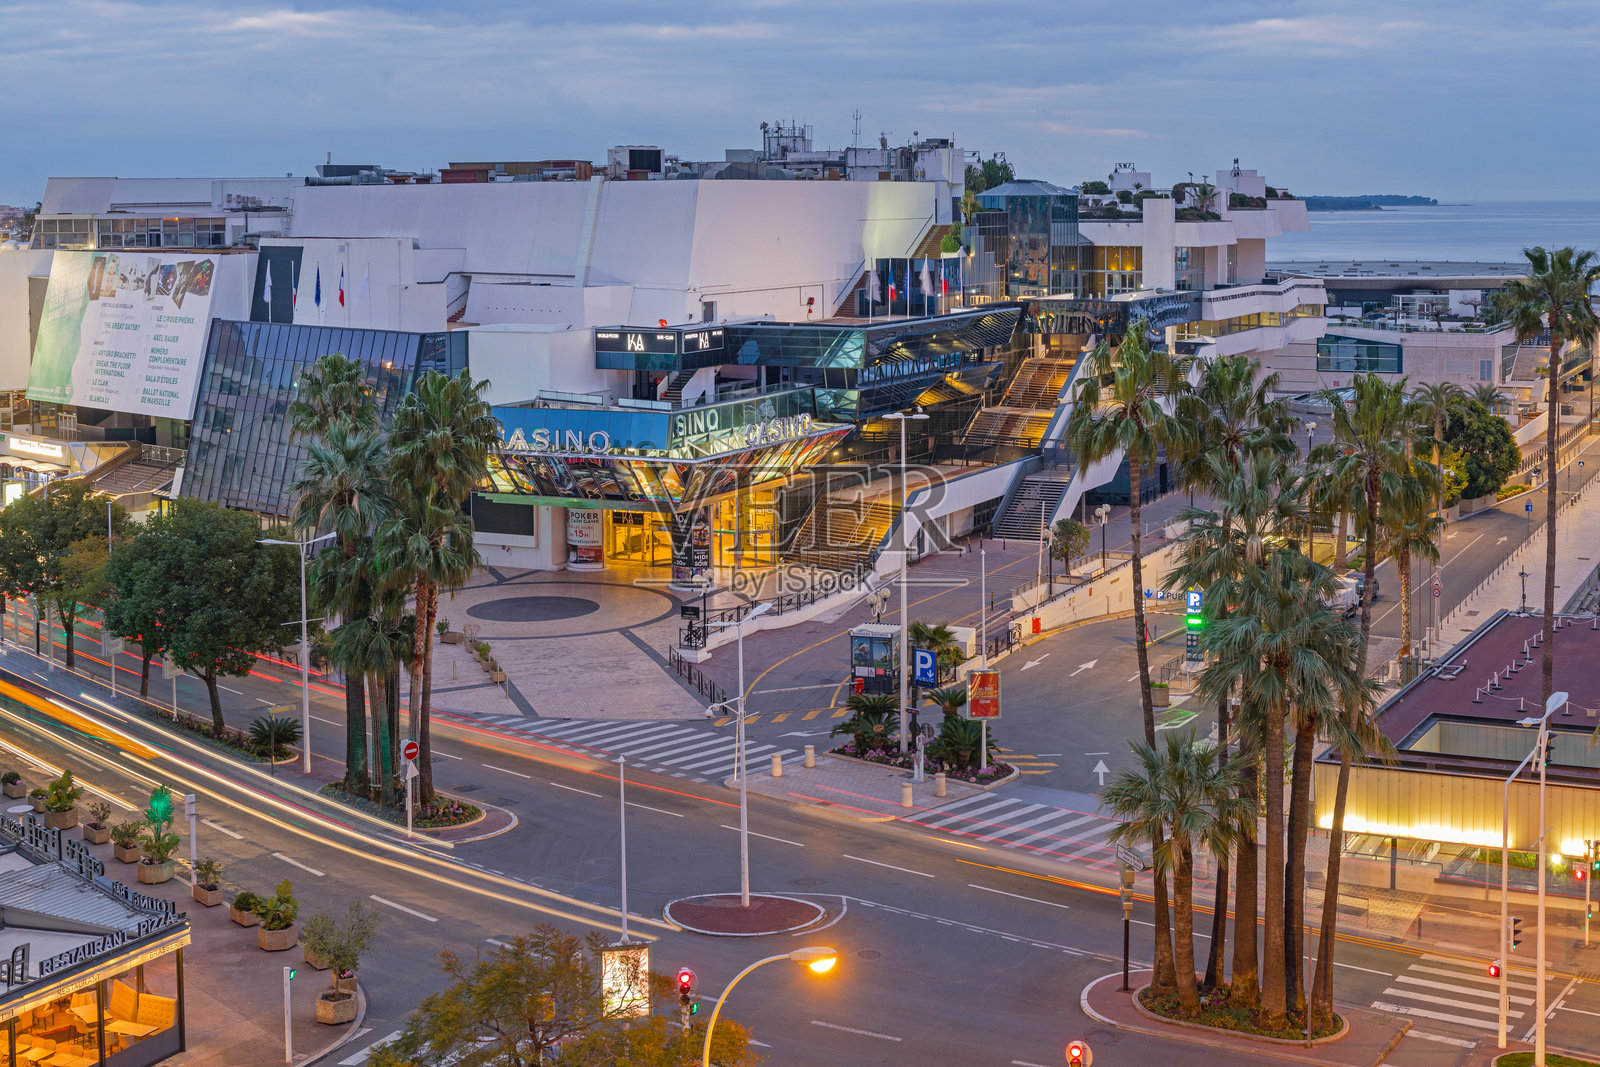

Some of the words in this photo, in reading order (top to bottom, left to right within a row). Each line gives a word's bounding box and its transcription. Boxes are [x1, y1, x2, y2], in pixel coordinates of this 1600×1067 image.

[672, 408, 719, 438] SINO
[745, 412, 812, 446] CASINO
[570, 512, 599, 520] POKER
[1166, 592, 1187, 600] PUBL
[1190, 592, 1200, 606] P
[916, 650, 932, 676] P
[40, 929, 129, 976] RESTAURANT
[138, 911, 174, 938] PIZZA
[56, 973, 100, 996] RESTAURANT
[150, 938, 185, 959] BRASSERIE
